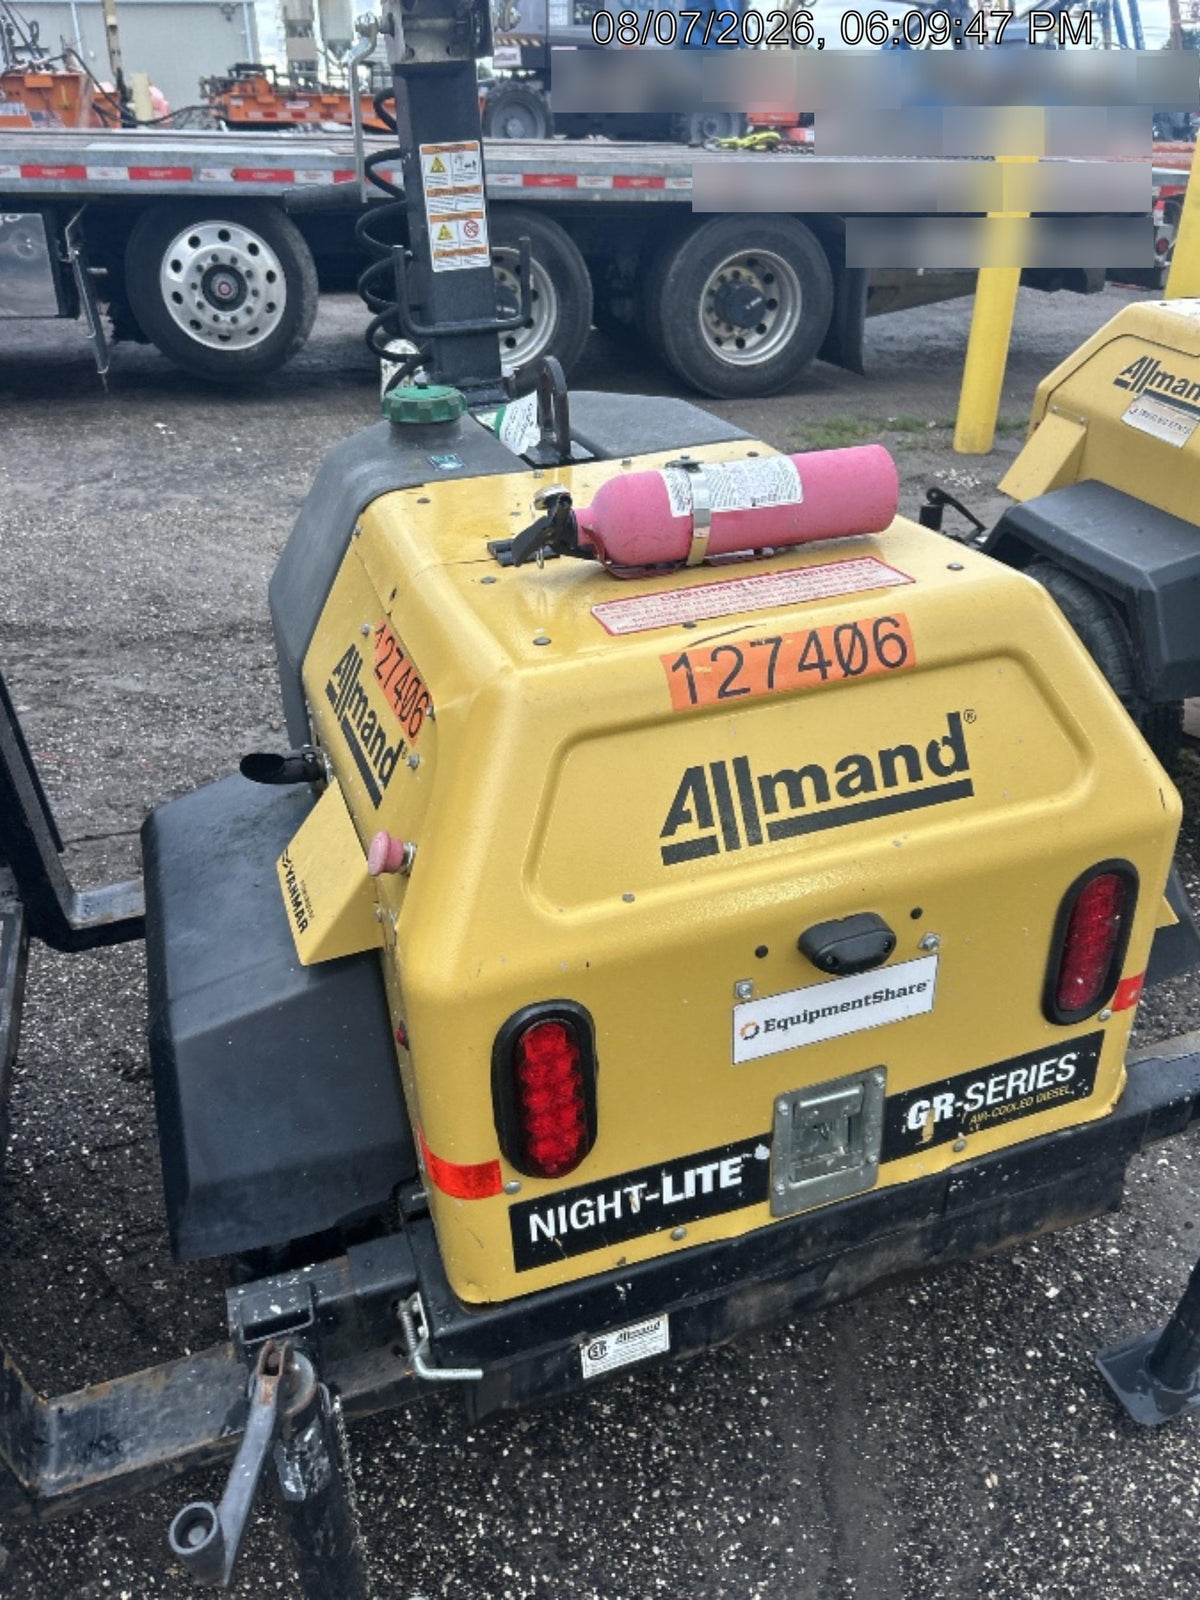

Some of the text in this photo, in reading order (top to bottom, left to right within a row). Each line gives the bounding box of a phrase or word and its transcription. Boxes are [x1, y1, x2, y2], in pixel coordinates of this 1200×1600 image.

[374, 623, 430, 739] 127406
[671, 616, 908, 705] 127406
[906, 1051, 1079, 1131] GR-SERIES
[969, 1084, 1071, 1126] AIR-COOLED DIESEL
